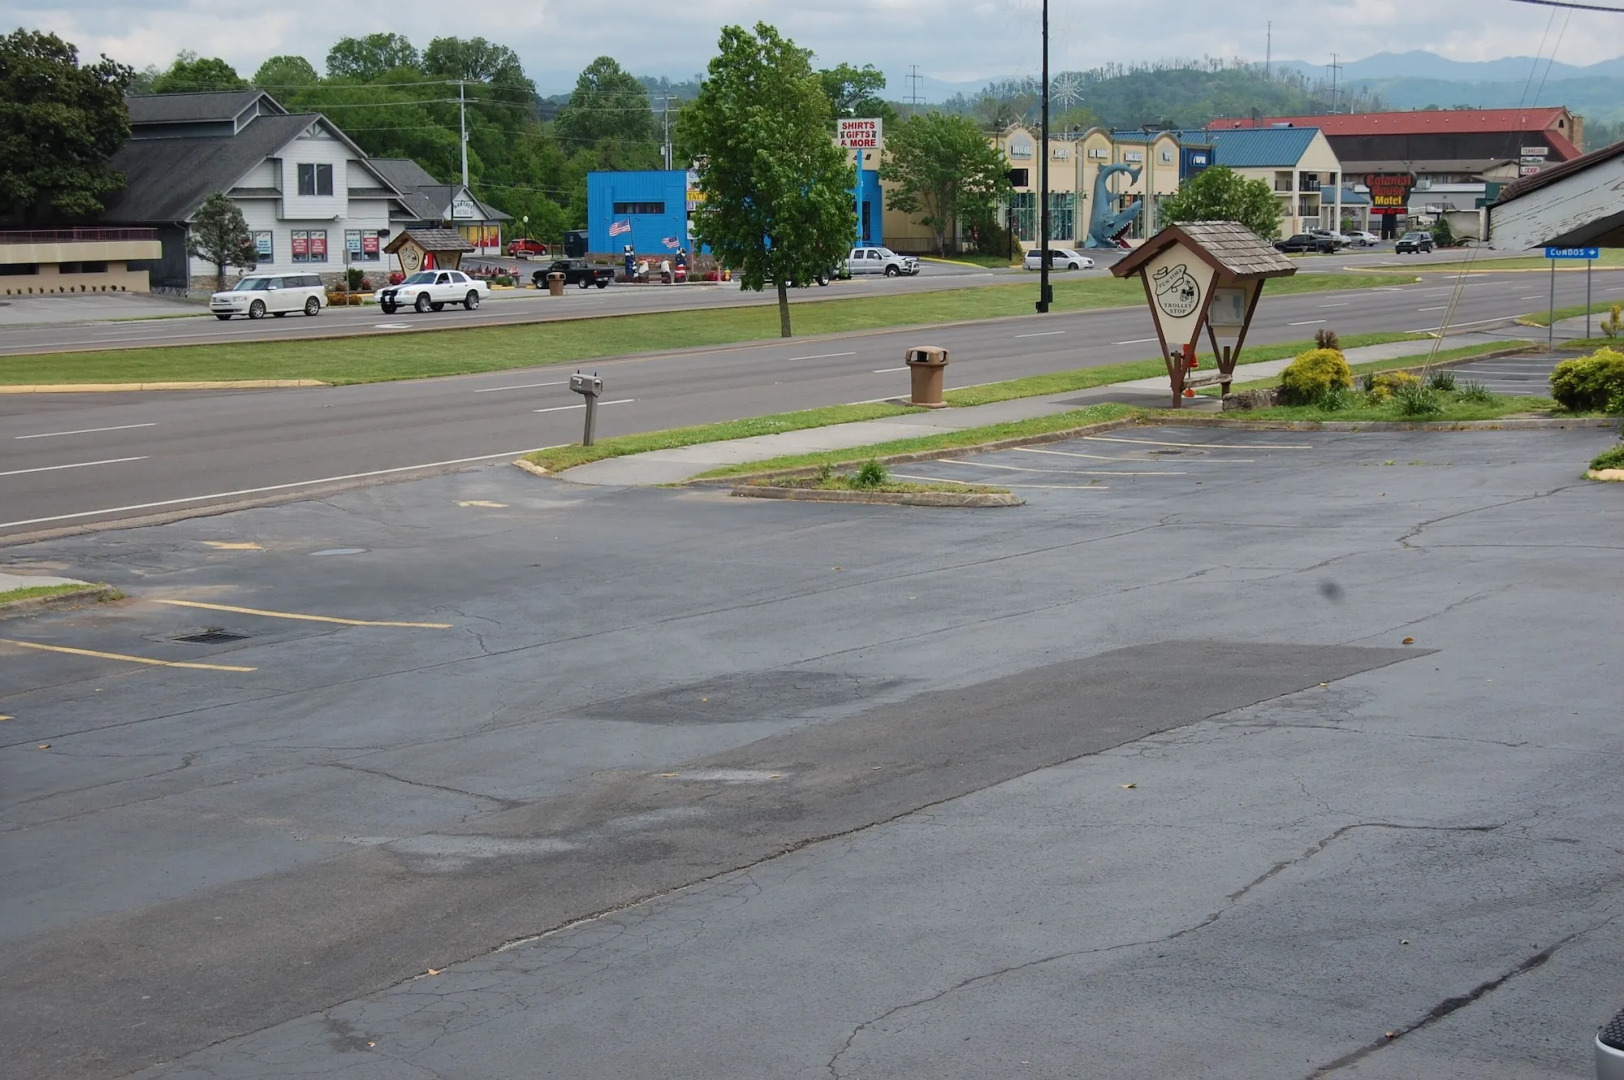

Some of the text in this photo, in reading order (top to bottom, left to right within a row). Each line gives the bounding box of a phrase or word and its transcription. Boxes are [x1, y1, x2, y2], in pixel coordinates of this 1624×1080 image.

[842, 121, 875, 130] SHIRTS
[846, 130, 871, 139] GIFTS
[840, 139, 876, 147] & MORE
[1366, 174, 1412, 186] Colonial
[1375, 195, 1402, 205] Motel
[1158, 267, 1183, 289] FUN TIME
